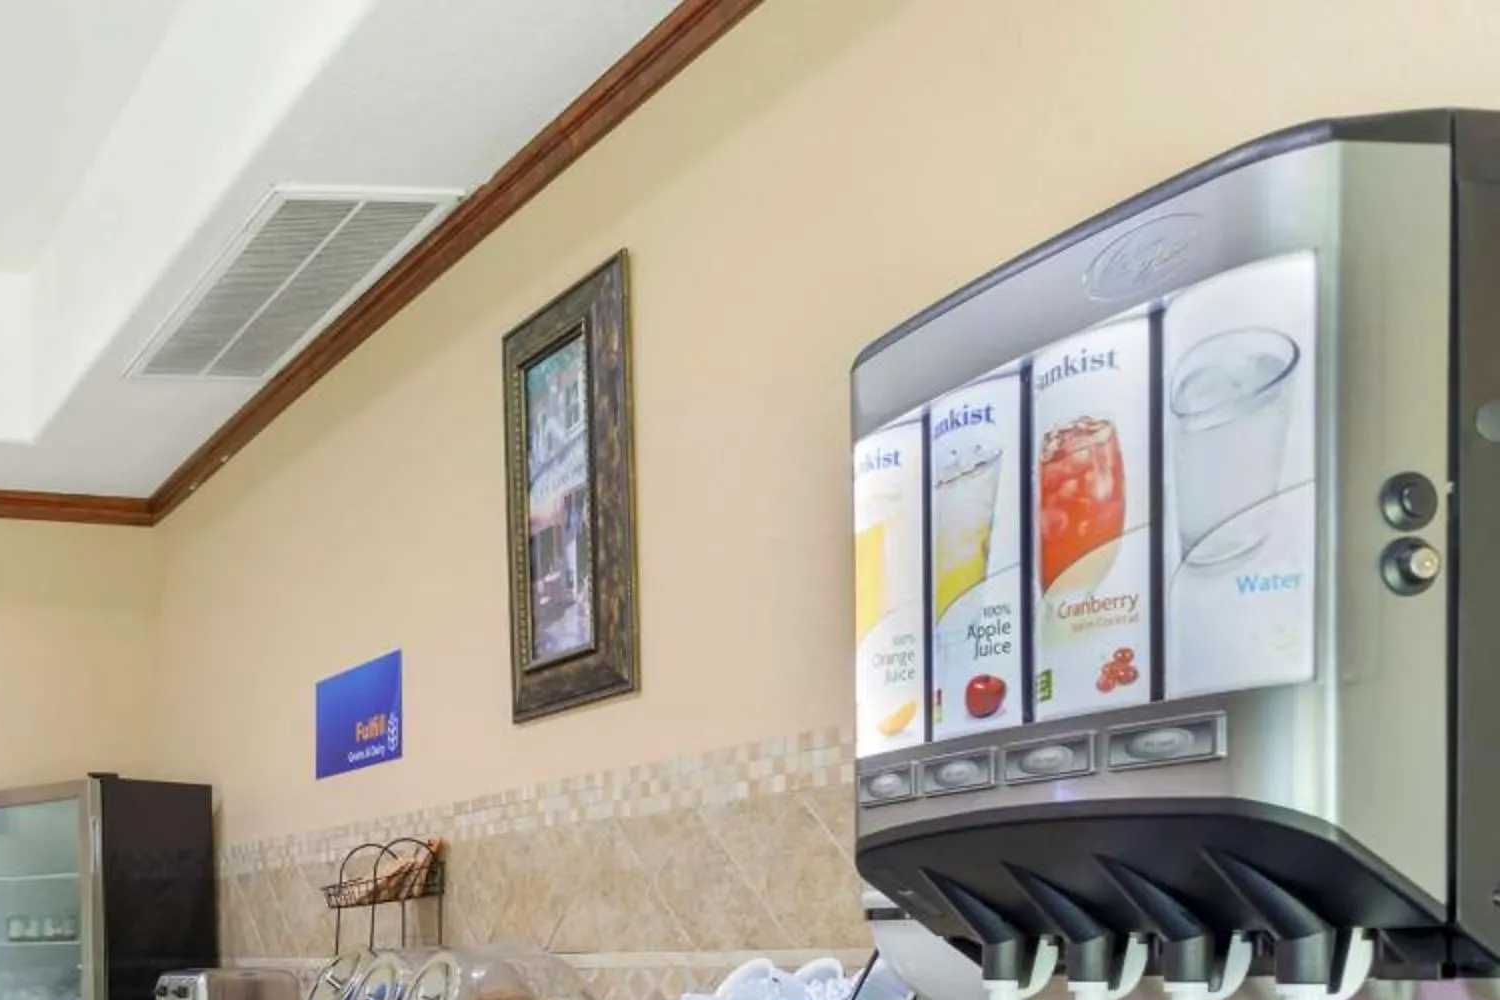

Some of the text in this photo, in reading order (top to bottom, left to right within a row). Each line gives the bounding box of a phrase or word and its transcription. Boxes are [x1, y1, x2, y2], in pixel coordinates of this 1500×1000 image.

[1235, 571, 1302, 594] Water
[982, 603, 1011, 618] 100%
[1057, 593, 1139, 620] Cranberry
[967, 619, 1012, 641] Apple
[872, 650, 916, 667] Orange
[973, 640, 1012, 660] Juice
[884, 668, 916, 685] Juice
